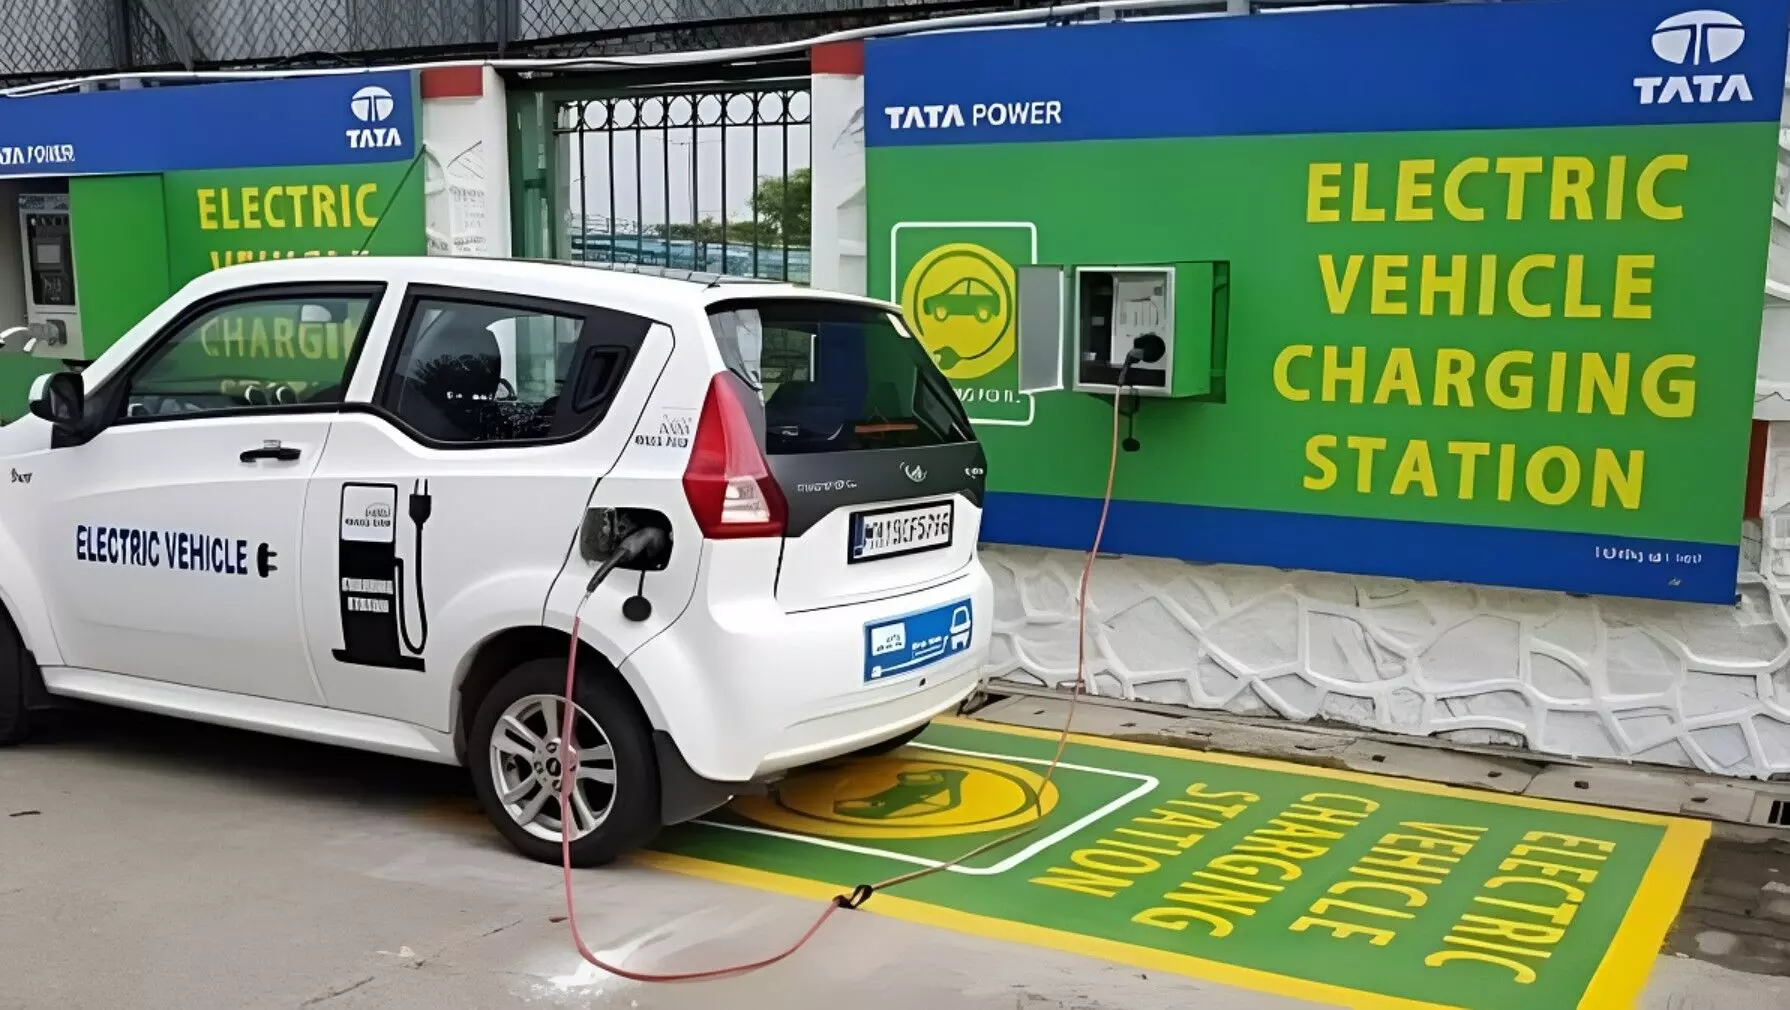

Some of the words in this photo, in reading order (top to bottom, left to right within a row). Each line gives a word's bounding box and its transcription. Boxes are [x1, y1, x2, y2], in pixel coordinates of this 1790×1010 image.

[885, 103, 966, 130] TATA
[972, 100, 1062, 127] POWER
[1633, 73, 1754, 105] TATA
[345, 127, 402, 149] TATA
[197, 183, 378, 230] ELECTRIC
[1306, 154, 1689, 223] ELECTRIC
[1318, 254, 1655, 319] VEHICLE
[1273, 345, 1696, 418] CHARGING
[1303, 434, 1645, 509] STATION
[76, 524, 160, 567] ELECTRIC
[164, 531, 248, 575] VEHICLE
[1028, 783, 1260, 898] STATION
[1131, 792, 1380, 937] CHARGING
[1288, 821, 1490, 946] VEHICLE
[1424, 830, 1617, 984] ELECTRIC
